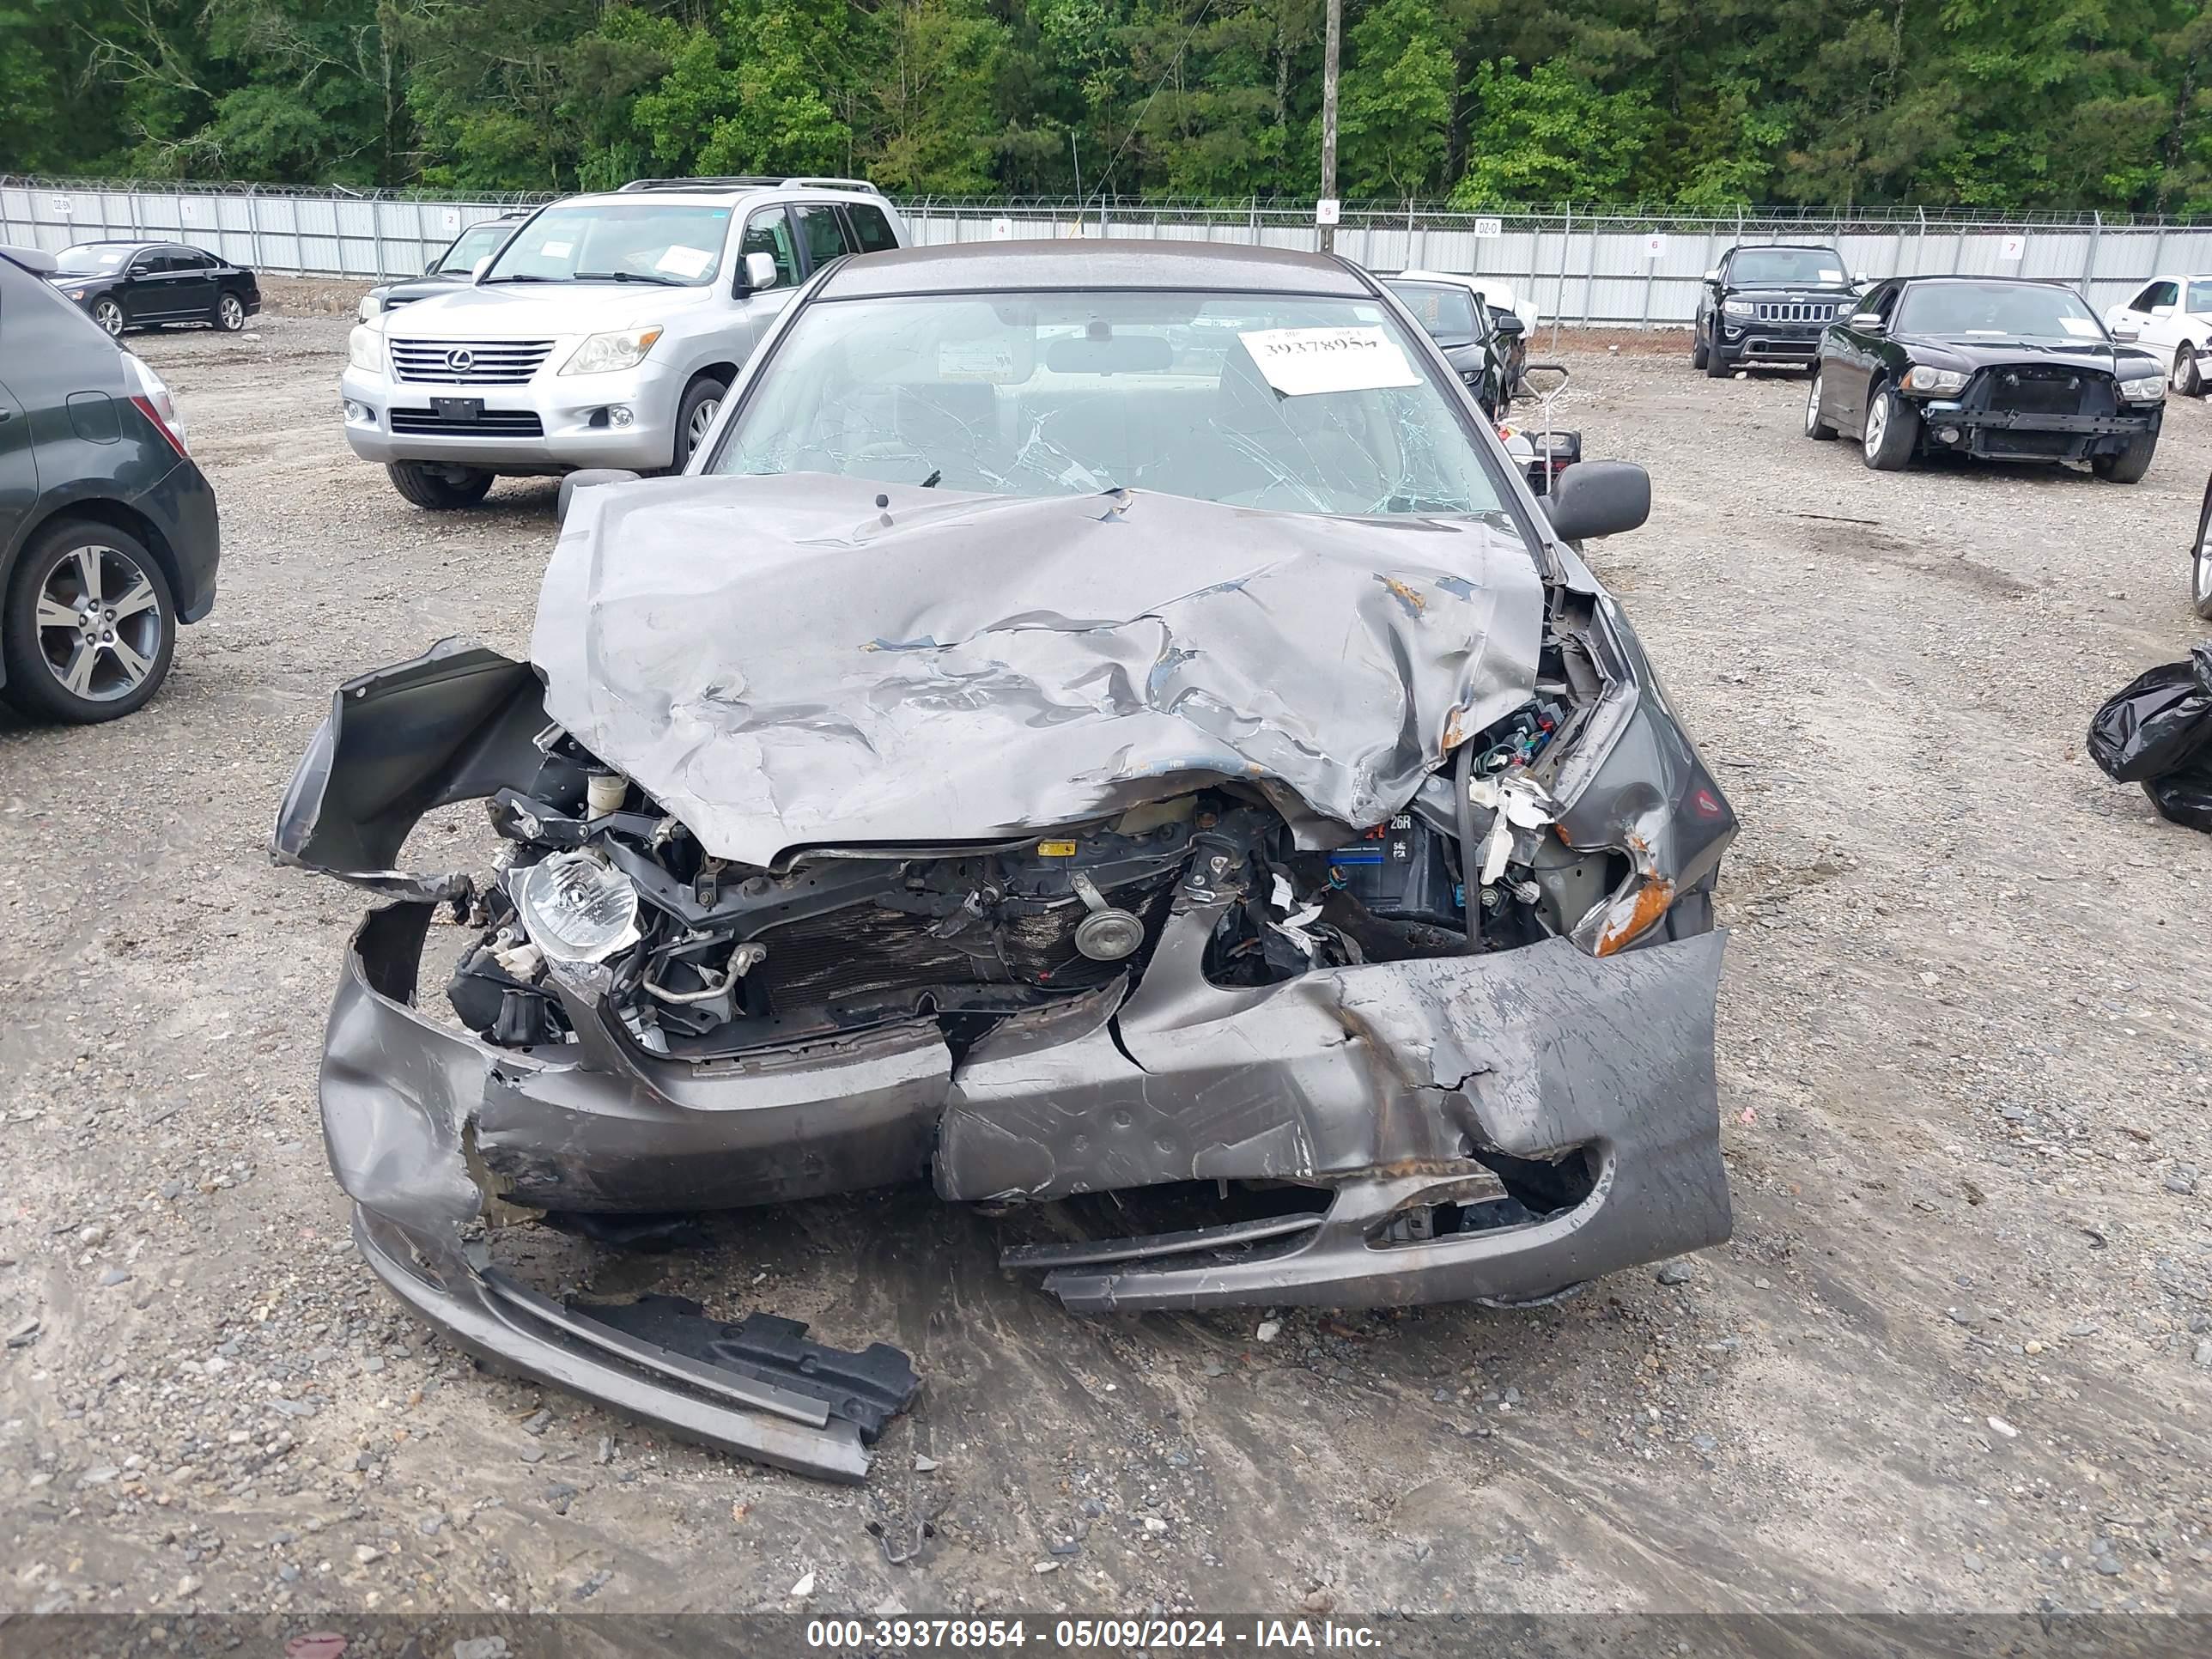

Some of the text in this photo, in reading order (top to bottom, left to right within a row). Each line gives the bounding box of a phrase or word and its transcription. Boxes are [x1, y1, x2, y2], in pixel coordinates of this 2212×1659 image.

[1325, 207, 1331, 216] 5
[1651, 240, 1658, 249] 6
[2009, 242, 2016, 251] 7
[1390, 814, 1412, 830] 26R
